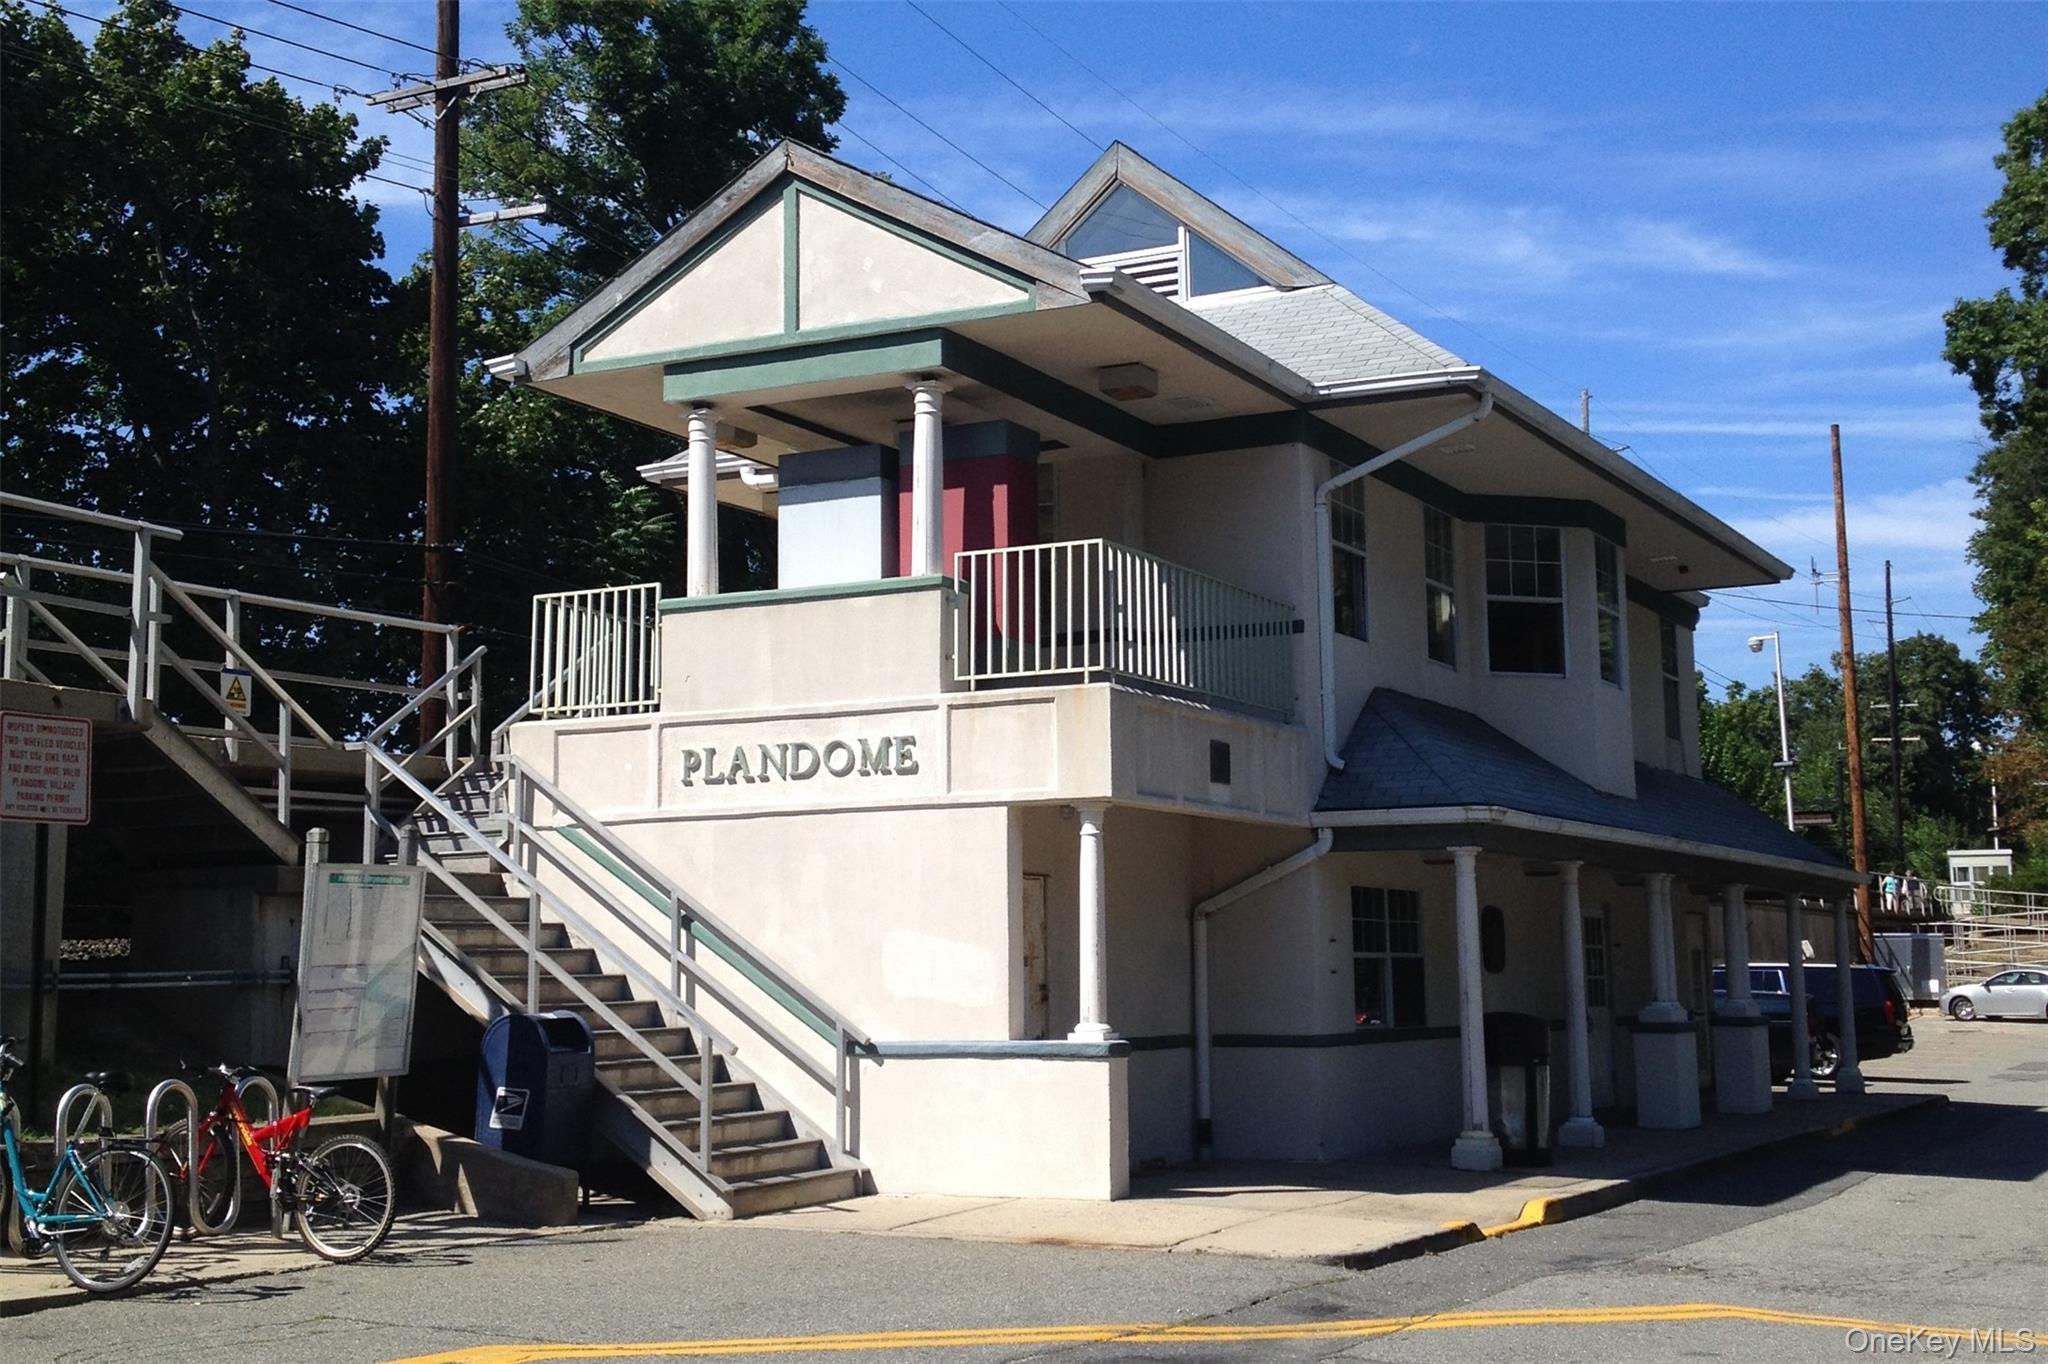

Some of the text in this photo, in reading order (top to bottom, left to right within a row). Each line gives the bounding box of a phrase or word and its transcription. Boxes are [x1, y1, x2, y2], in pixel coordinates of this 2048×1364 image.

[56, 739, 86, 751] VEHICLES
[10, 749, 28, 760] MUST
[681, 735, 920, 787] PLANDOME
[8, 763, 22, 774] AND
[23, 764, 42, 775] MUST
